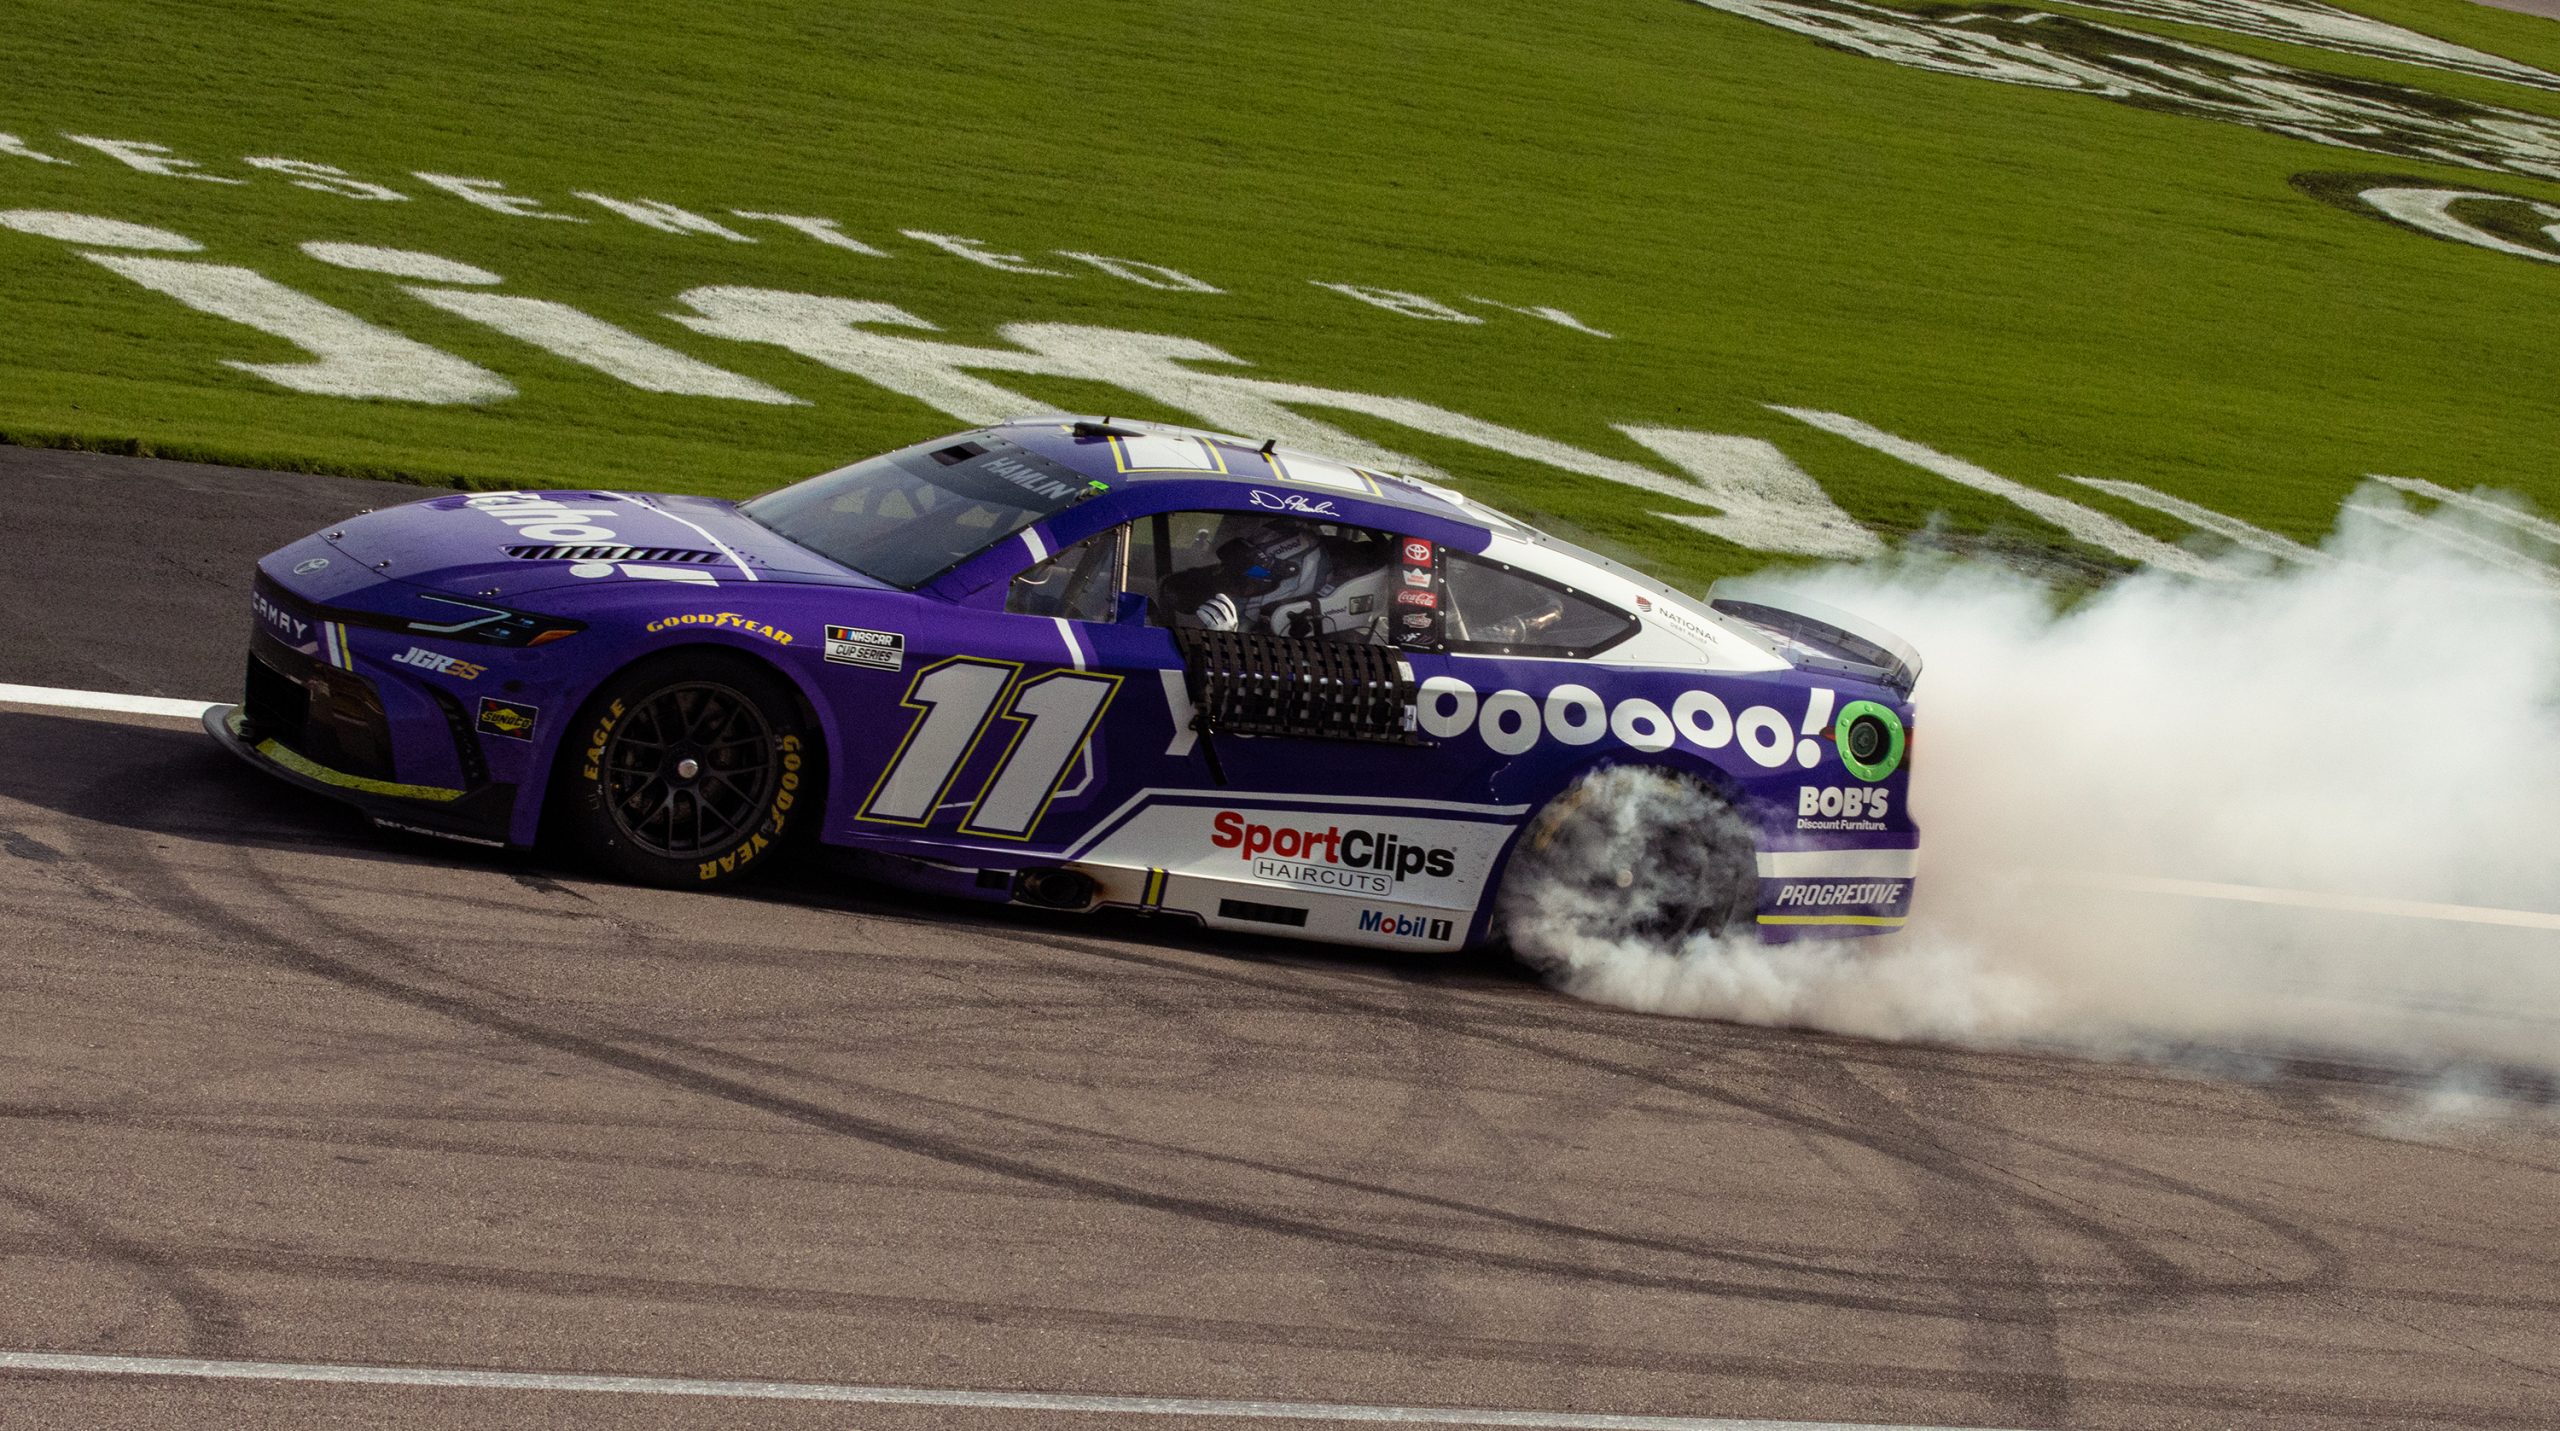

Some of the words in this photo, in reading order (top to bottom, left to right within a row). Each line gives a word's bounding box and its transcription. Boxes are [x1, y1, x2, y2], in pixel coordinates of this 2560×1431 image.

[980, 457, 1077, 500] HAMLIN
[252, 591, 308, 639] CAMRY
[646, 612, 794, 646] GOODYEAR
[1660, 607, 1718, 644] NATIONAL
[836, 644, 857, 657] CUP
[856, 647, 893, 662] SERIES
[850, 630, 893, 646] NASCAR
[481, 710, 533, 729] SUNOCO
[583, 698, 626, 781] EAGLE
[854, 654, 1126, 842] 11
[699, 734, 802, 881] GOODYEAR
[1798, 786, 1890, 819] BOB'S
[1796, 818, 1842, 830] Discount
[1210, 810, 1455, 882] SportClips
[1258, 861, 1386, 893] HAIRCUTS
[1775, 883, 1905, 906] PROGRESSIVE
[1358, 909, 1426, 938] Mobil
